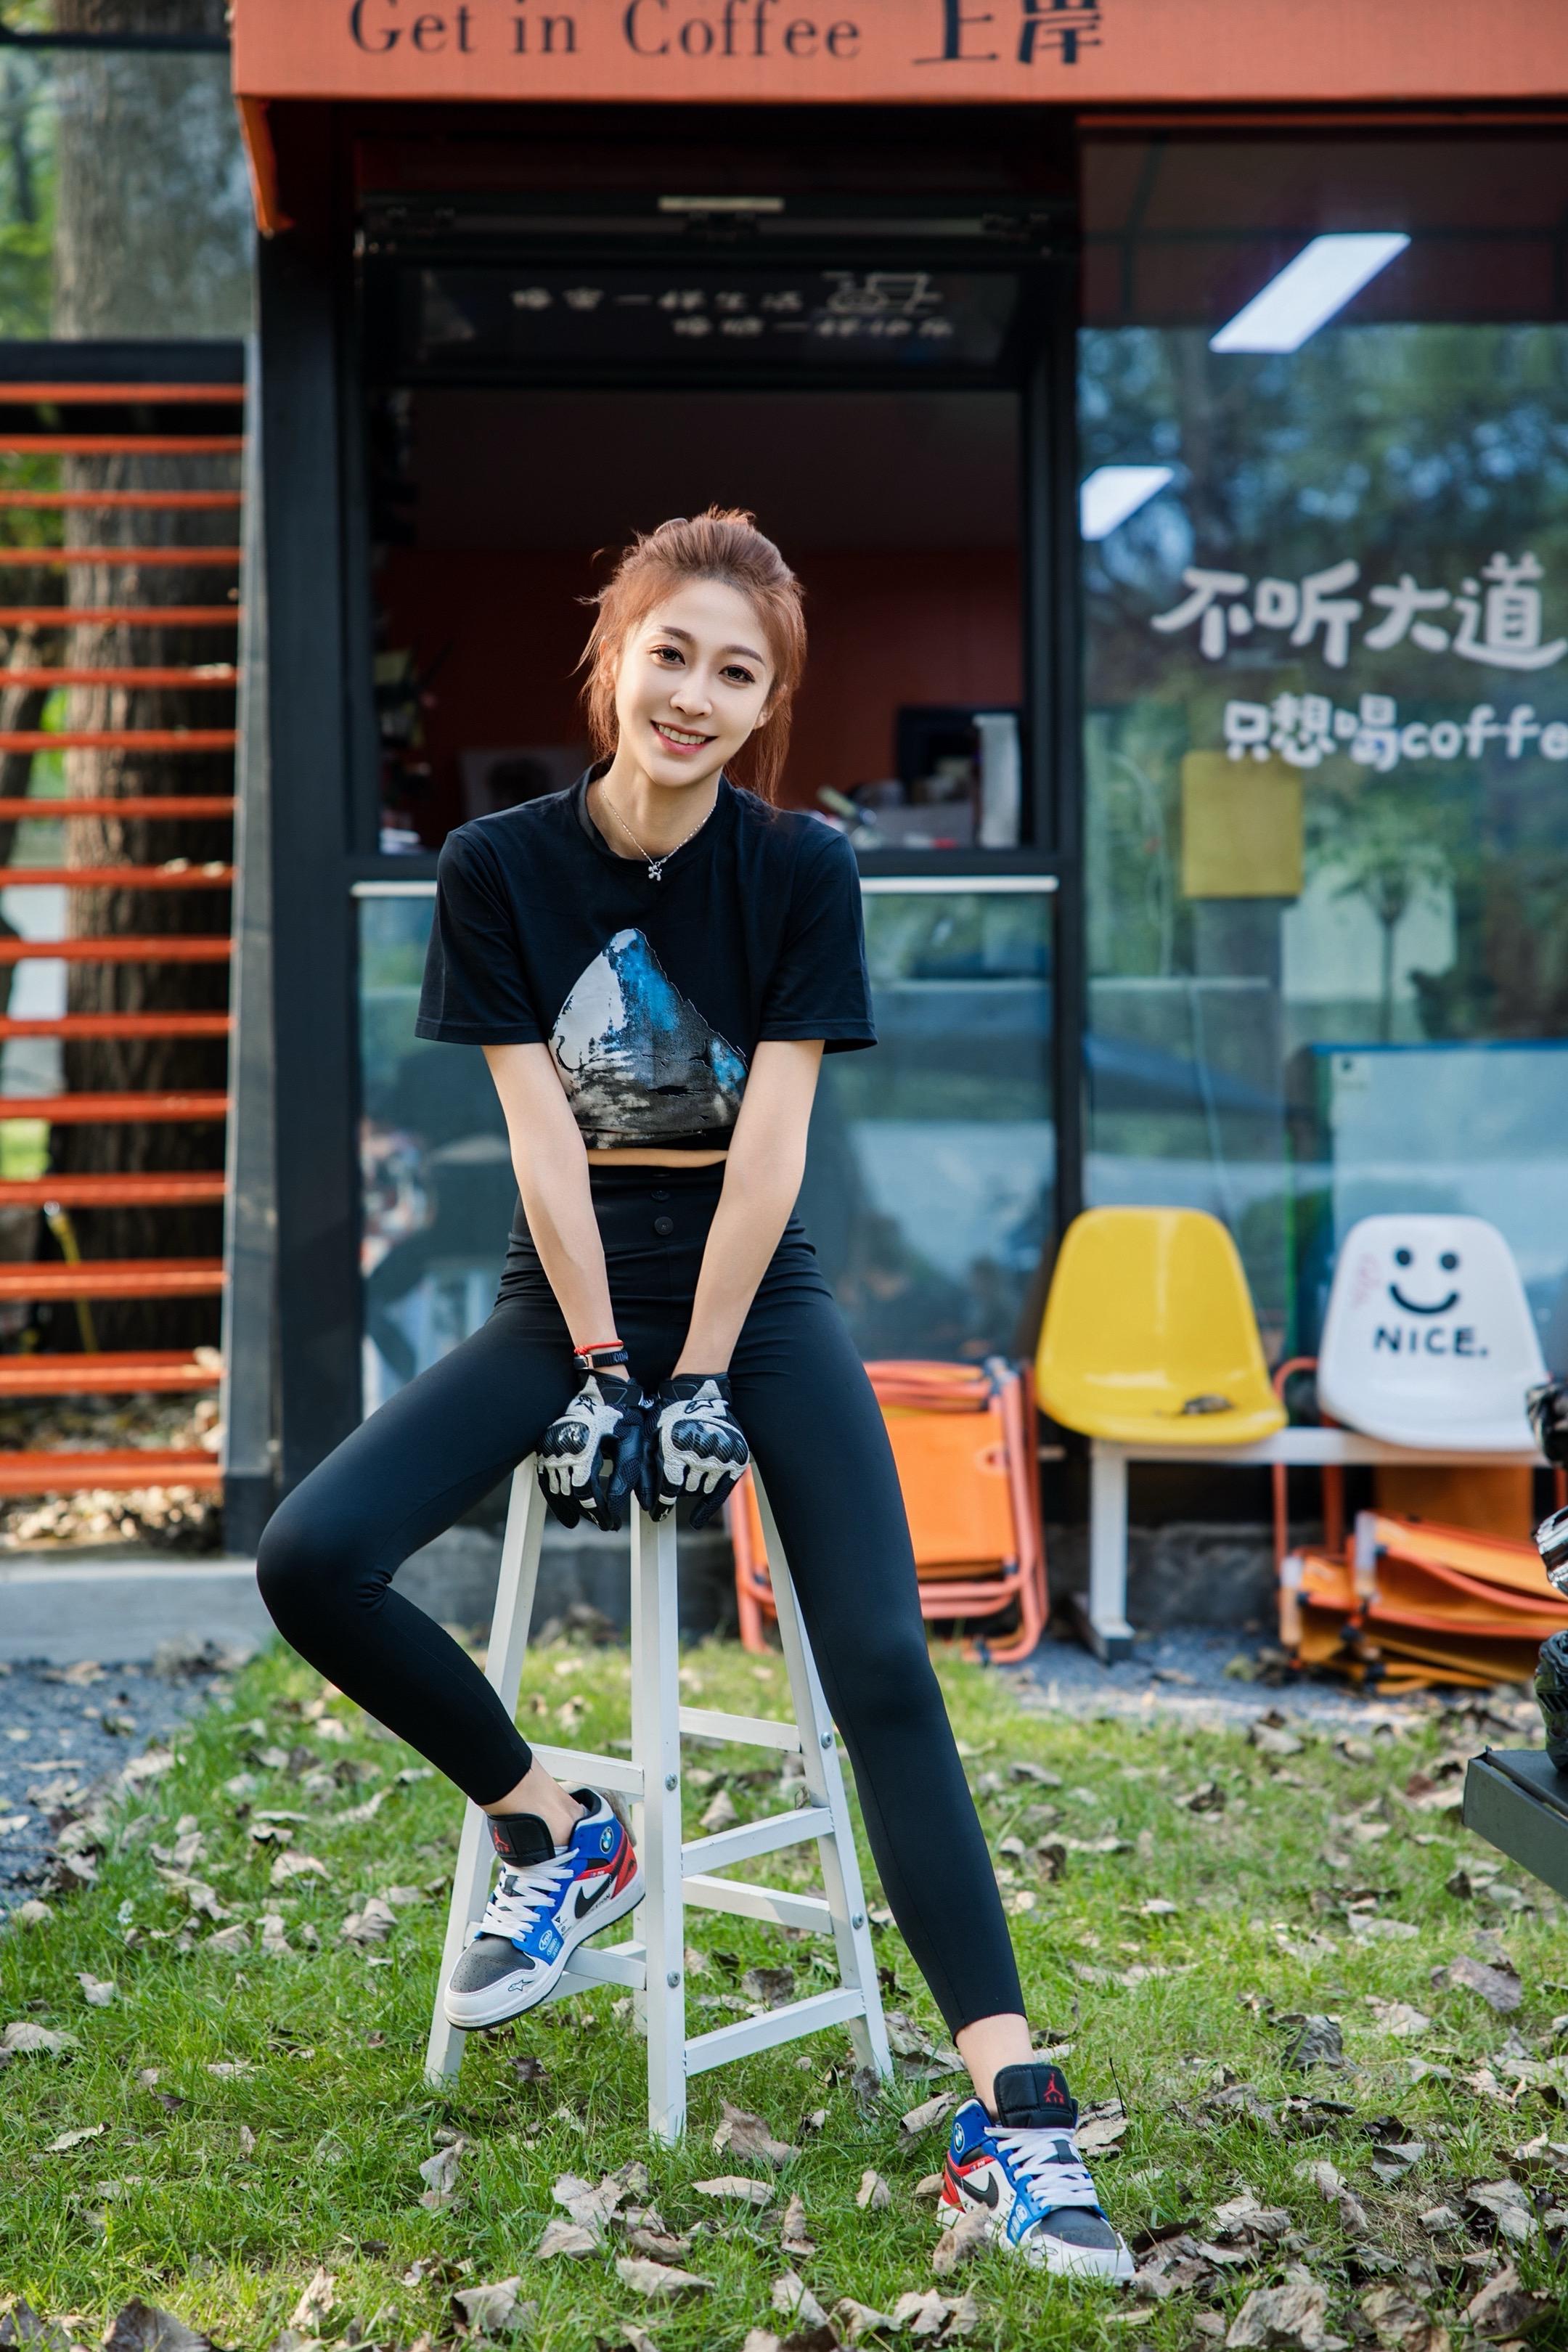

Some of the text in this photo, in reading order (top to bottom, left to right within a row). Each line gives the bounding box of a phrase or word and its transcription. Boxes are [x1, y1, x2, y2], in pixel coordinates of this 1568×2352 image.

[348, 0, 1103, 65] Get in Coffee 上岸
[1151, 552, 1568, 670] 不听大道
[1373, 1326, 1489, 1357] NICE.
